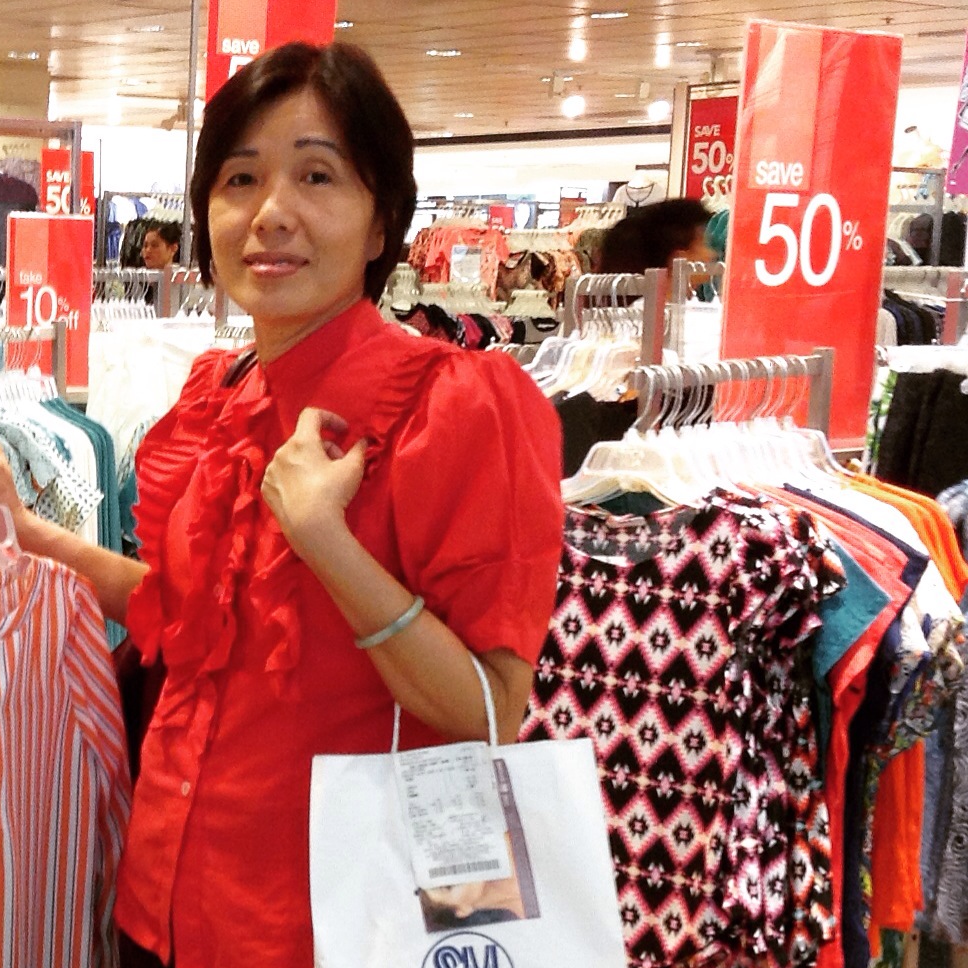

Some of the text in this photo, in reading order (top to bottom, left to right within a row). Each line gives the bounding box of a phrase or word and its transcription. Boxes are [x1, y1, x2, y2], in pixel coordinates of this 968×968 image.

[222, 38, 260, 54] save
[694, 124, 721, 138] SAVE
[755, 160, 804, 187] save
[755, 192, 864, 287] 50%
[19, 271, 43, 285] take
